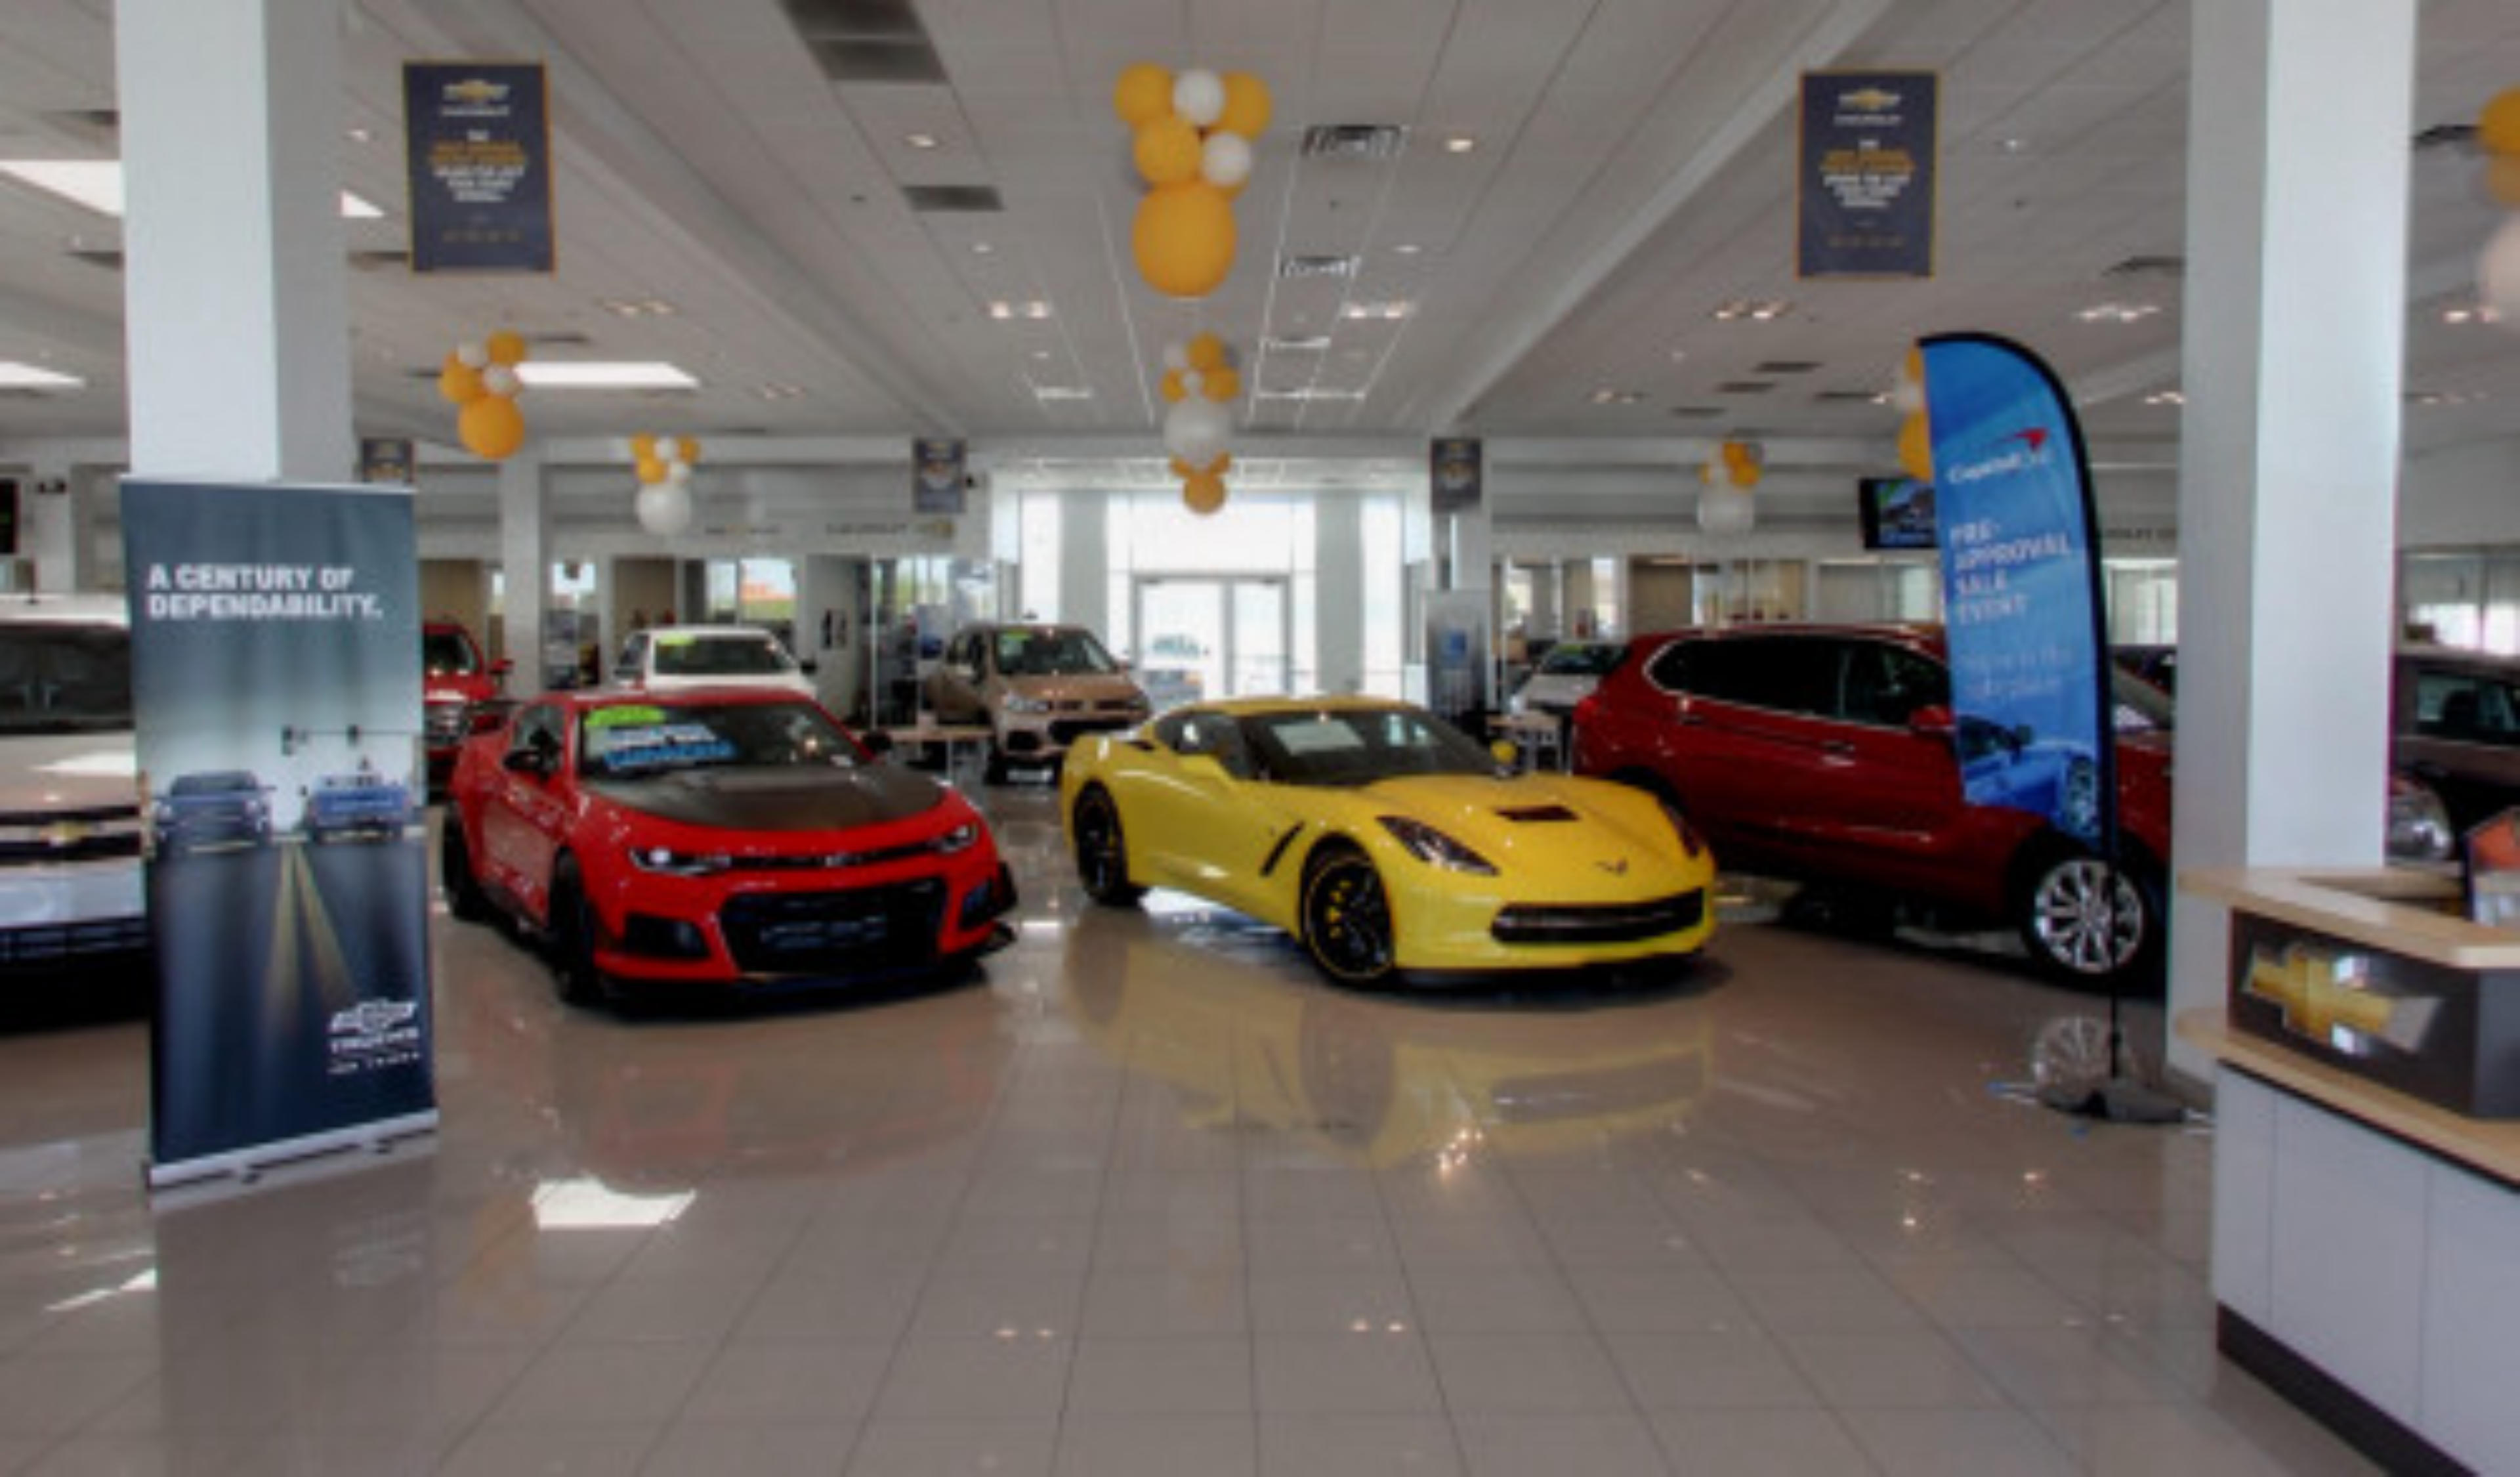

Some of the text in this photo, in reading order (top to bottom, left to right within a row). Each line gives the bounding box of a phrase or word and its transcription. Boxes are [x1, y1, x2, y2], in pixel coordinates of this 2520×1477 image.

[1950, 521, 2001, 547] PRE-
[1955, 532, 2071, 570] APPROVAL
[148, 563, 354, 589] A CENTURY OF
[1956, 569, 2006, 594] SALE
[148, 592, 384, 619] DEPENDABILITY.
